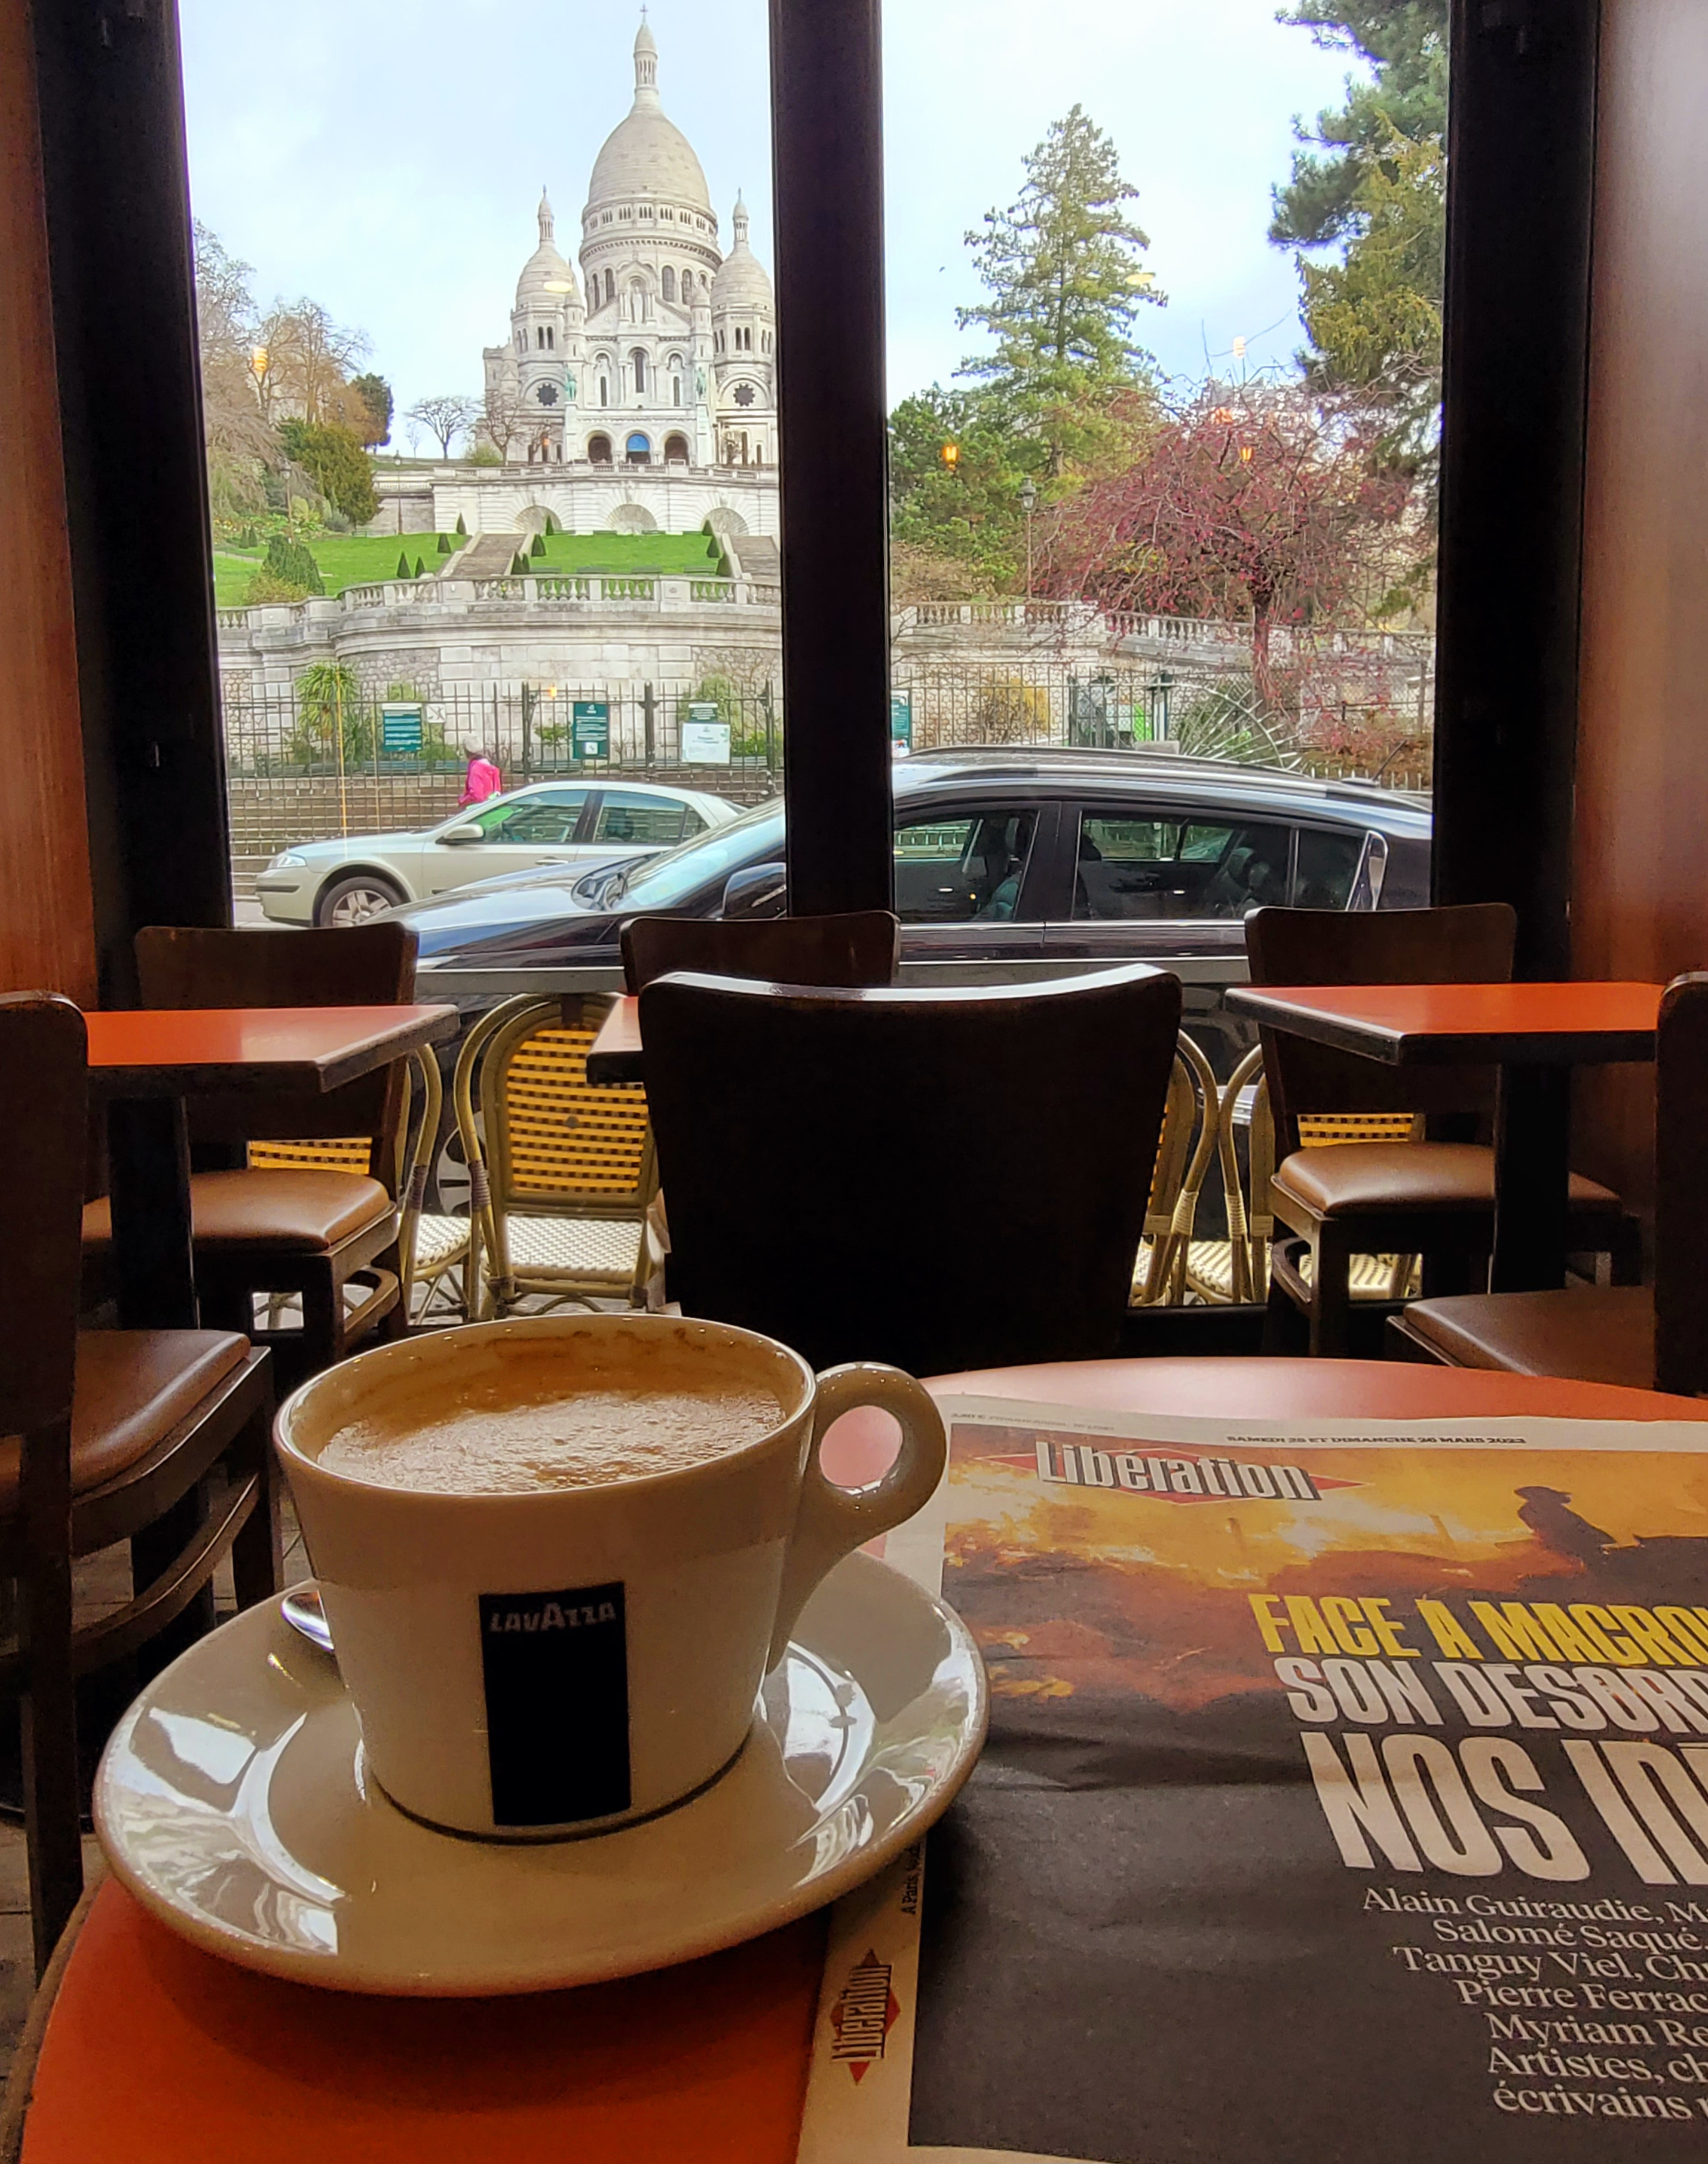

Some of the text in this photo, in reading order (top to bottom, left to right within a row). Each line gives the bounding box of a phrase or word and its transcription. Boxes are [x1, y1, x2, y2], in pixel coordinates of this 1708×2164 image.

[1036, 1440, 1322, 1501] Libération
[490, 1602, 617, 1632] LAVAZZA
[1248, 1594, 1422, 1657] FACE
[1467, 1601, 1708, 1666] MACRO
[1274, 1657, 1445, 1726] SON
[1300, 1731, 1708, 1885] NOS ID
[1363, 1887, 1463, 1914] Alain
[1465, 1894, 1665, 1924] Guiraudie,
[1432, 1919, 1578, 1946] Salomé
[1392, 1946, 1542, 1981] Tanguy
[1546, 1951, 1643, 1982] Viel,
[1452, 1979, 1578, 2009] Pierre
[1482, 2012, 1657, 2047] Myriam
[1487, 2046, 1665, 2084] Artistes,
[1493, 2080, 1693, 2120] écrivains
